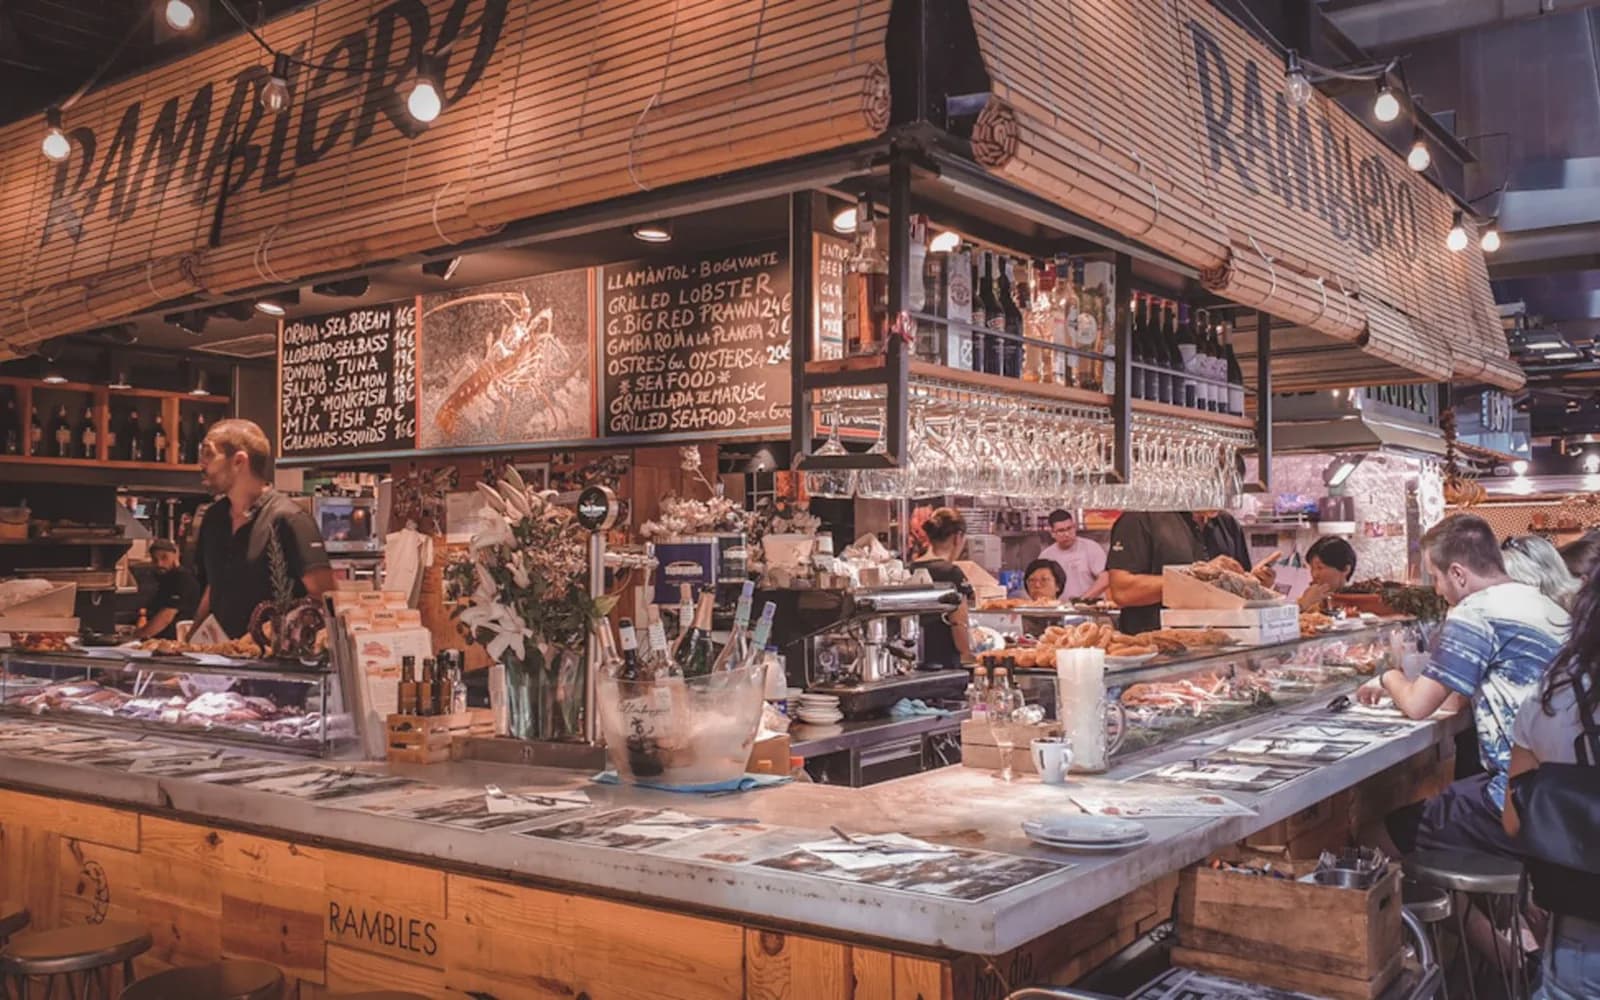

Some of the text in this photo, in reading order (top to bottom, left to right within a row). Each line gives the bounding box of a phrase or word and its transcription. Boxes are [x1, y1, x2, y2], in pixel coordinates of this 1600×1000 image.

[700, 252, 779, 278] BOGAVANTE
[679, 272, 774, 305] LOBSTER
[348, 310, 391, 334] BREAM
[656, 309, 694, 331] RED
[700, 300, 759, 324] PRAWN
[356, 333, 389, 355] BASS
[607, 332, 649, 355] GAMBA
[337, 356, 379, 375] TUNA
[608, 355, 666, 376] OSTRES
[689, 349, 753, 371] OYSTERS
[334, 372, 388, 392] SALMON
[283, 396, 315, 417] RAP
[610, 391, 695, 415] GRAELLADA
[670, 407, 736, 430] SEAFOOD
[282, 432, 338, 450] CALAMARS
[329, 901, 438, 956] RAMBLES
